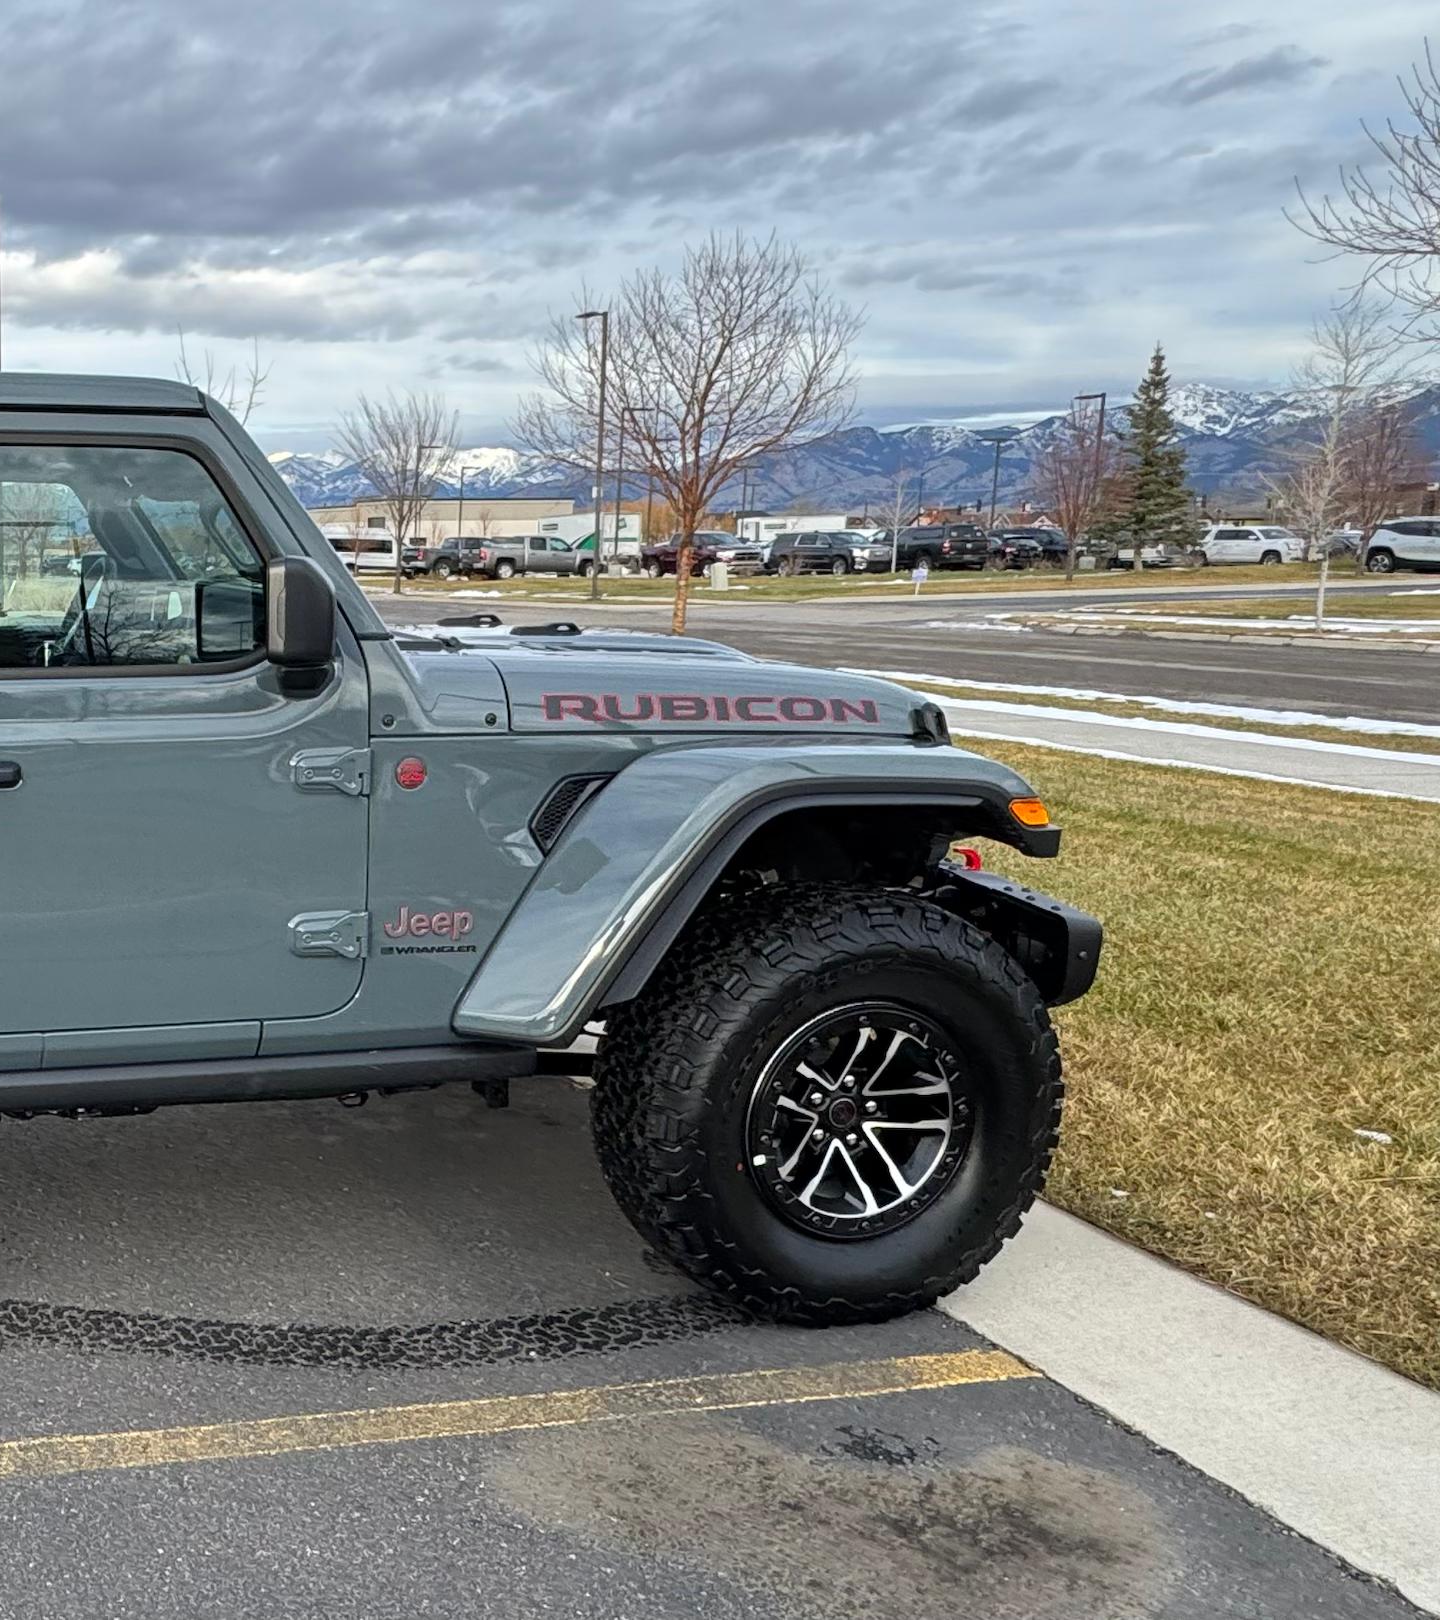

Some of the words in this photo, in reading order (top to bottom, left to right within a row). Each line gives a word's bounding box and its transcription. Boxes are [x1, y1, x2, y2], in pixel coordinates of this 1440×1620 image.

[541, 692, 881, 724] RUBICON
[384, 905, 474, 941] Jeep
[393, 945, 477, 955] WRANGLER
